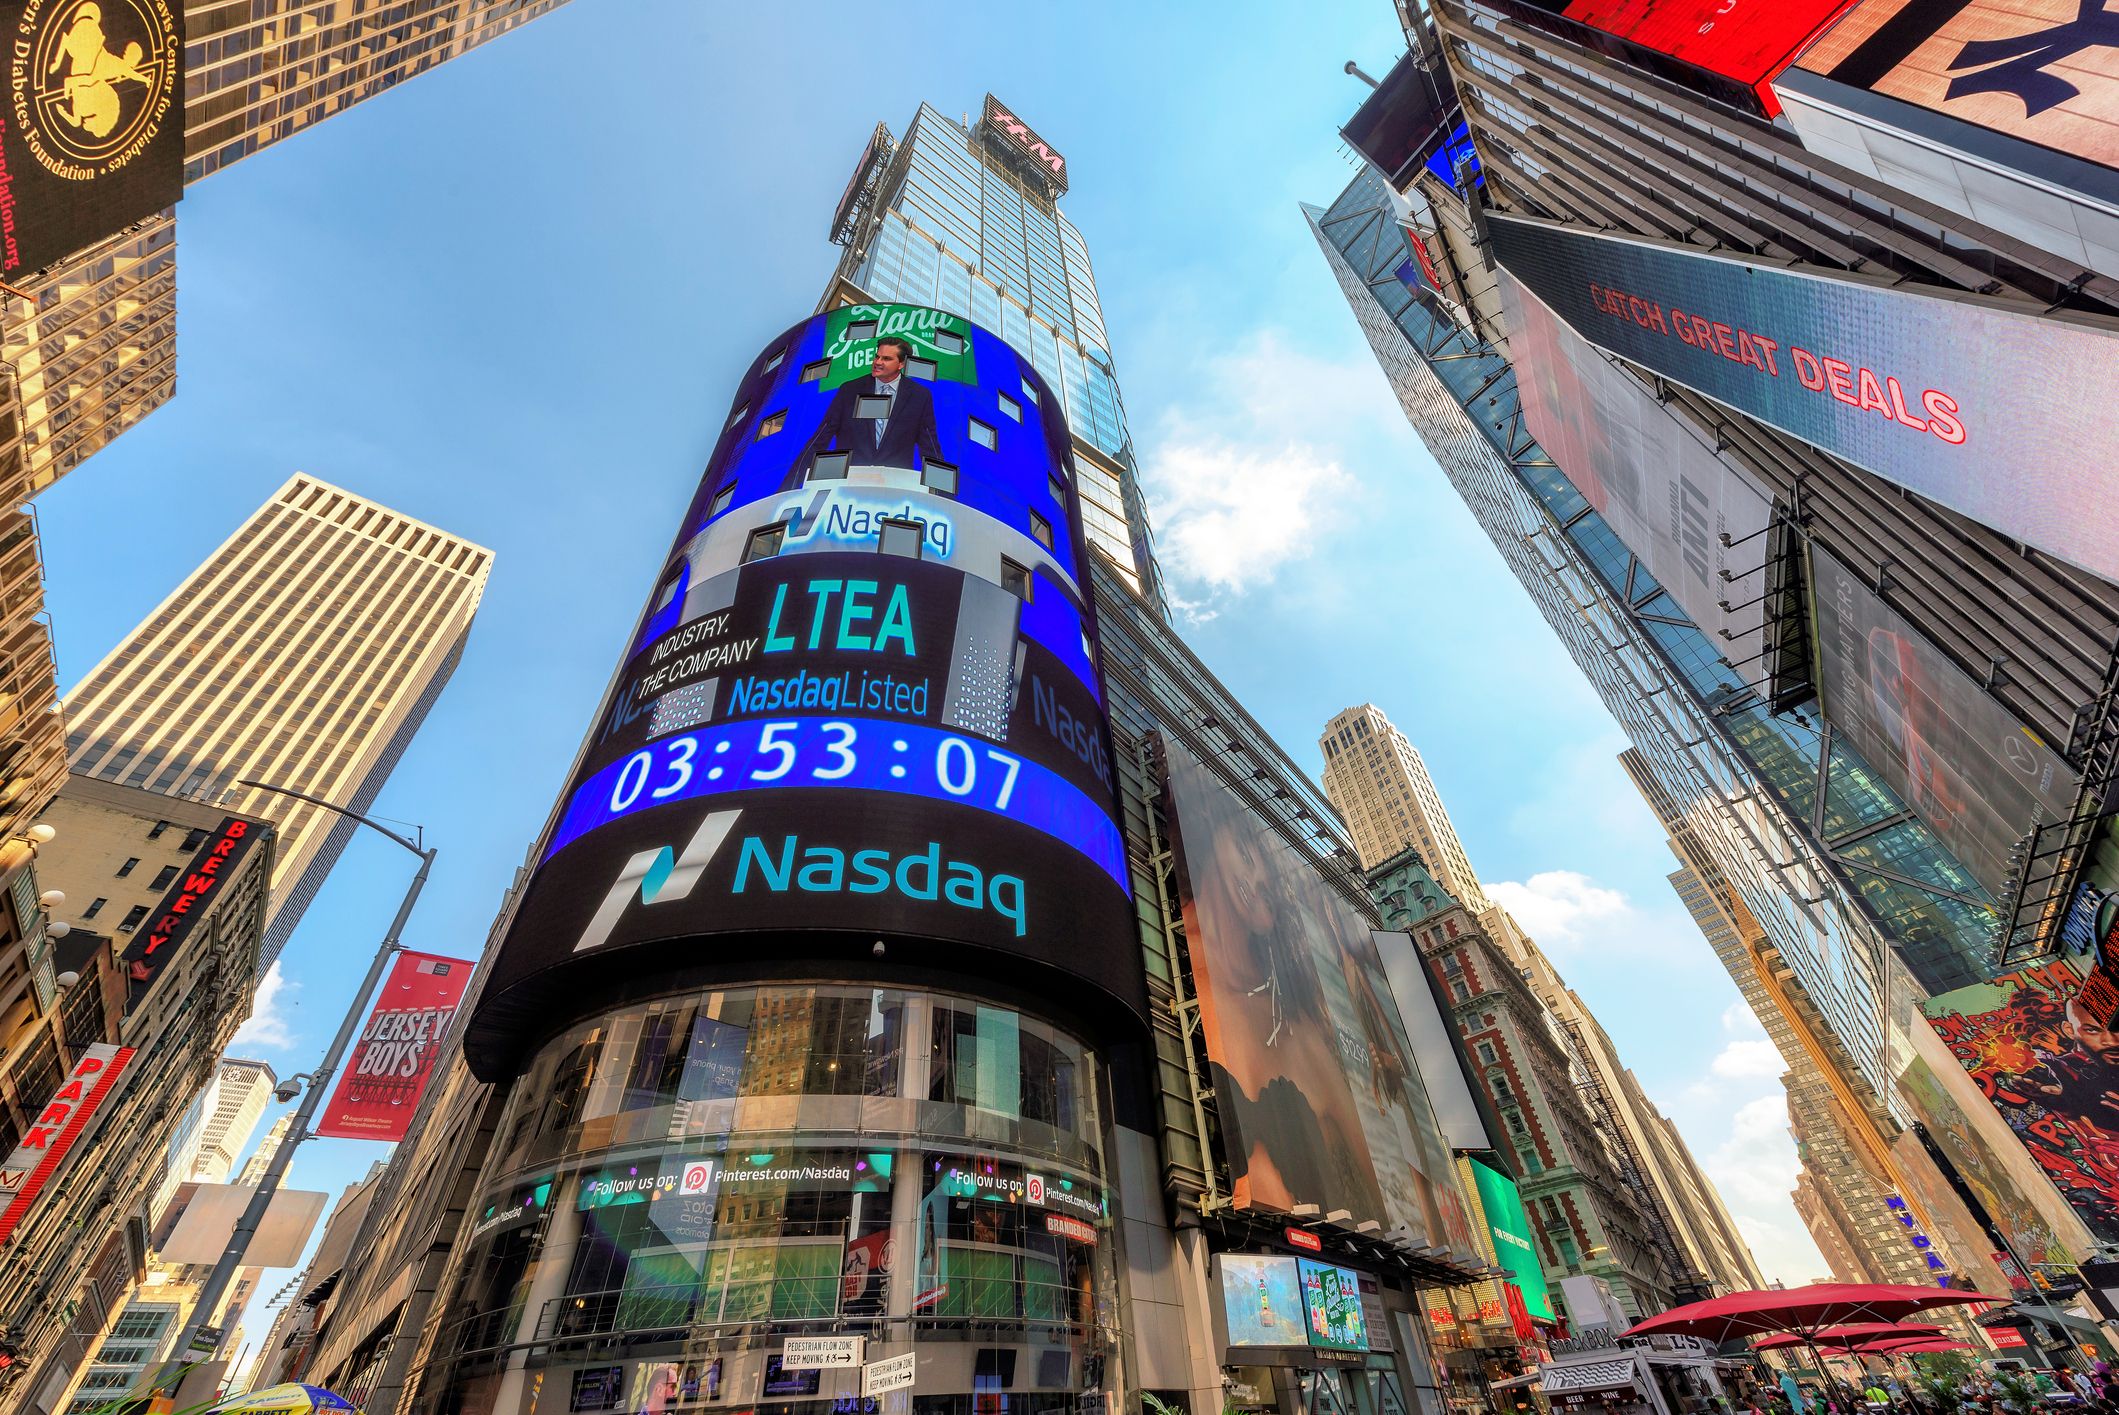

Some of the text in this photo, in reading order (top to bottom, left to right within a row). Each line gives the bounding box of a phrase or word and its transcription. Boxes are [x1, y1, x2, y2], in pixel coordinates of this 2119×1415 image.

[166, 35, 179, 86] Center
[12, 45, 31, 129] Diabetes
[24, 129, 95, 181] Foundation
[156, 95, 172, 123] for
[108, 124, 159, 174] Diabetes
[1589, 281, 1967, 445] CATCH GREAT DEALS
[1680, 473, 1709, 590] ANTI
[650, 613, 730, 666] INDUSTRY.
[1835, 575, 1854, 672] MATTERS
[638, 637, 759, 700] THE COMPANY
[144, 821, 248, 955] BREWERY
[731, 835, 1027, 938] Nasdaq
[362, 1010, 453, 1042] JERSEY
[356, 1041, 424, 1078] BOYS
[21, 1057, 104, 1149] PARK
[593, 1174, 678, 1197] Follow us on:
[714, 1166, 850, 1184] Pinterest.com/Nasdaq
[956, 1171, 1024, 1193] Follow us on:
[1047, 1218, 1082, 1237] BRANDED
[785, 1354, 801, 1365] KEEP
[801, 1353, 824, 1364] MOVING
[787, 1340, 853, 1352] PEDESTRIAN FLOW ZONE
[869, 1376, 894, 1391] KEEP MOVING
[870, 1357, 913, 1377] PEDESTRIAN FLOW ZONE
[1565, 1390, 1620, 1404] BEER WINE
